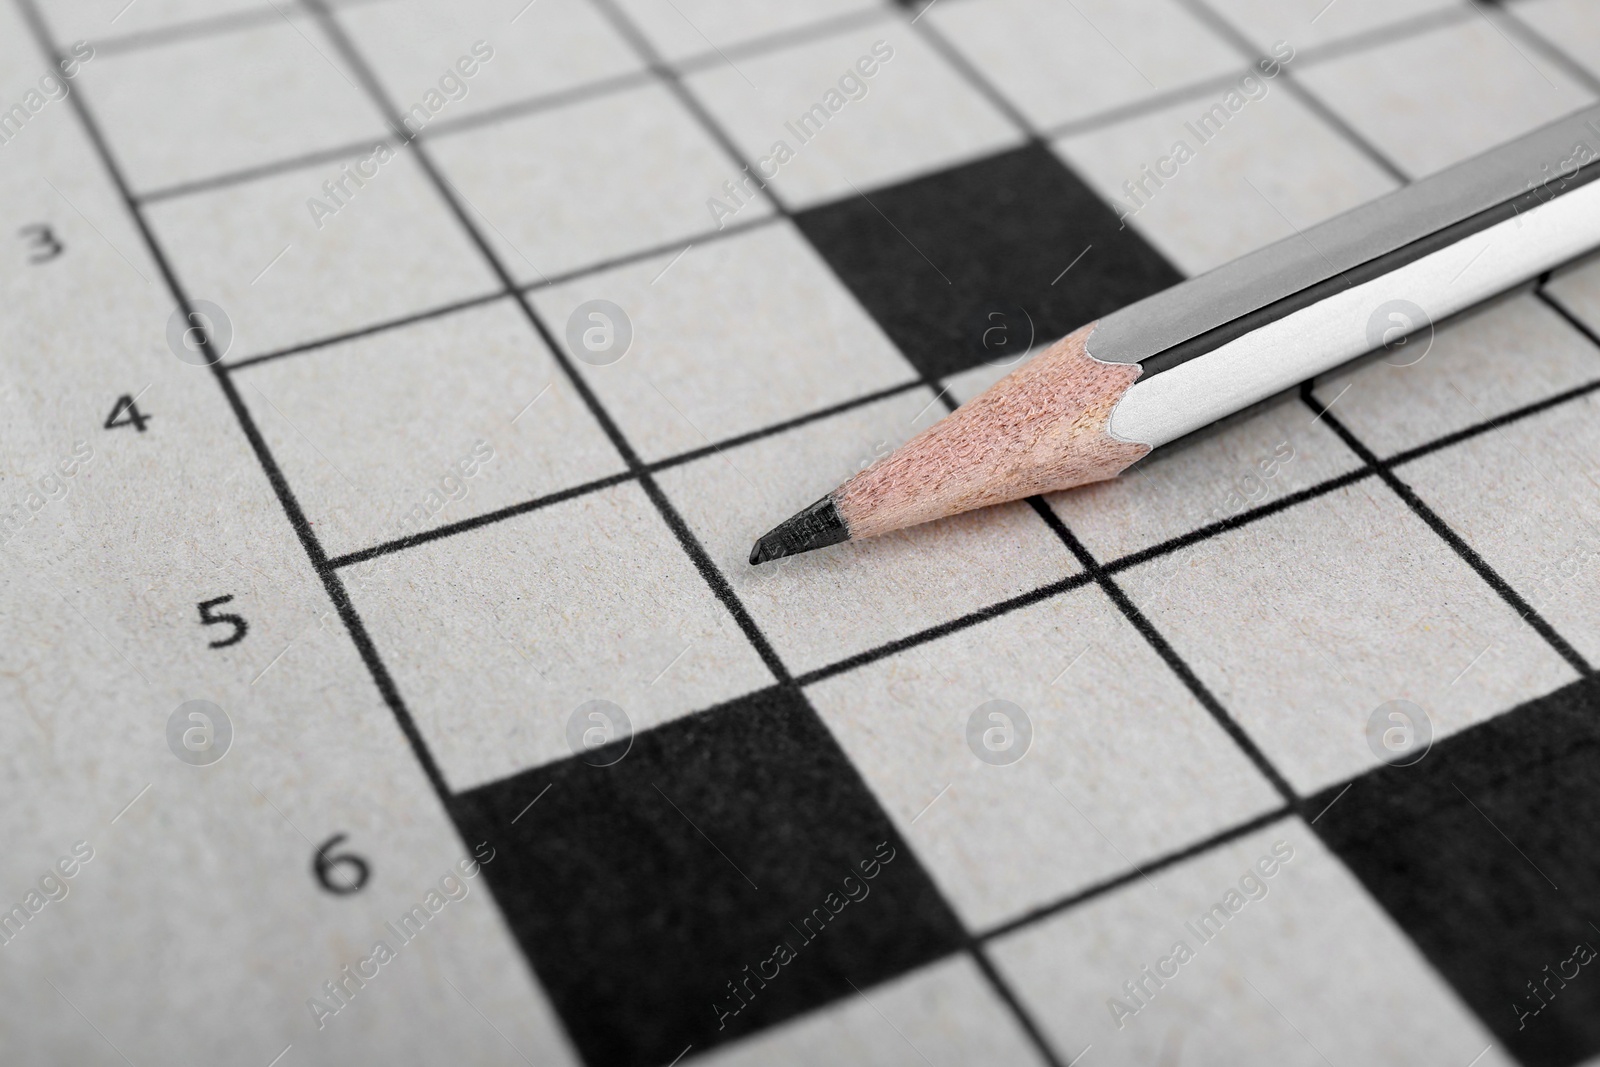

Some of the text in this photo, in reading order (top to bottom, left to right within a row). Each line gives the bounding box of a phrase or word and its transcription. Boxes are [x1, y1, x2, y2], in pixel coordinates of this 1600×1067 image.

[18, 222, 66, 265] 3
[103, 394, 151, 433] 4
[197, 594, 249, 649] 5
[311, 834, 372, 897] 6
